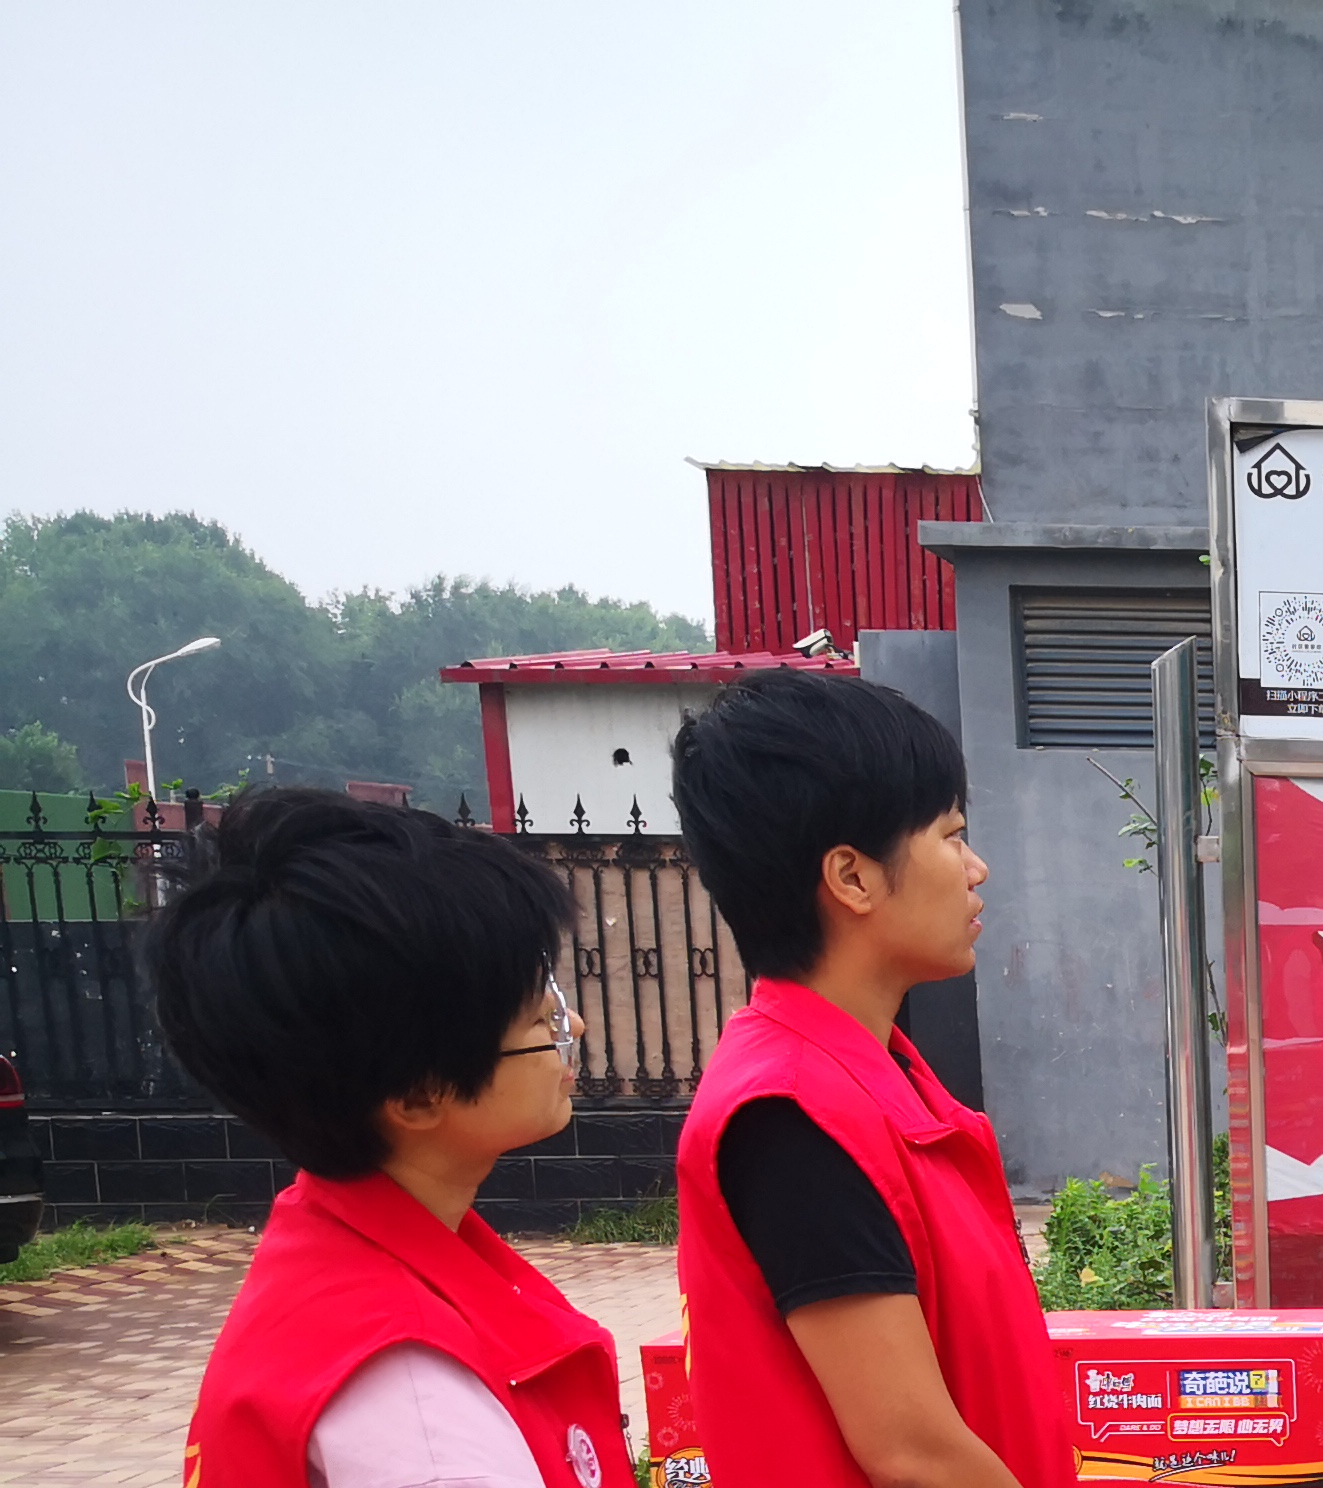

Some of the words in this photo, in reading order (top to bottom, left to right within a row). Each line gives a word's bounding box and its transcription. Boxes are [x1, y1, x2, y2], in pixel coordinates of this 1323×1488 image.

[1184, 1371, 1250, 1395] 奇葩说
[1087, 1392, 1163, 1410] 红烧牛肉面
